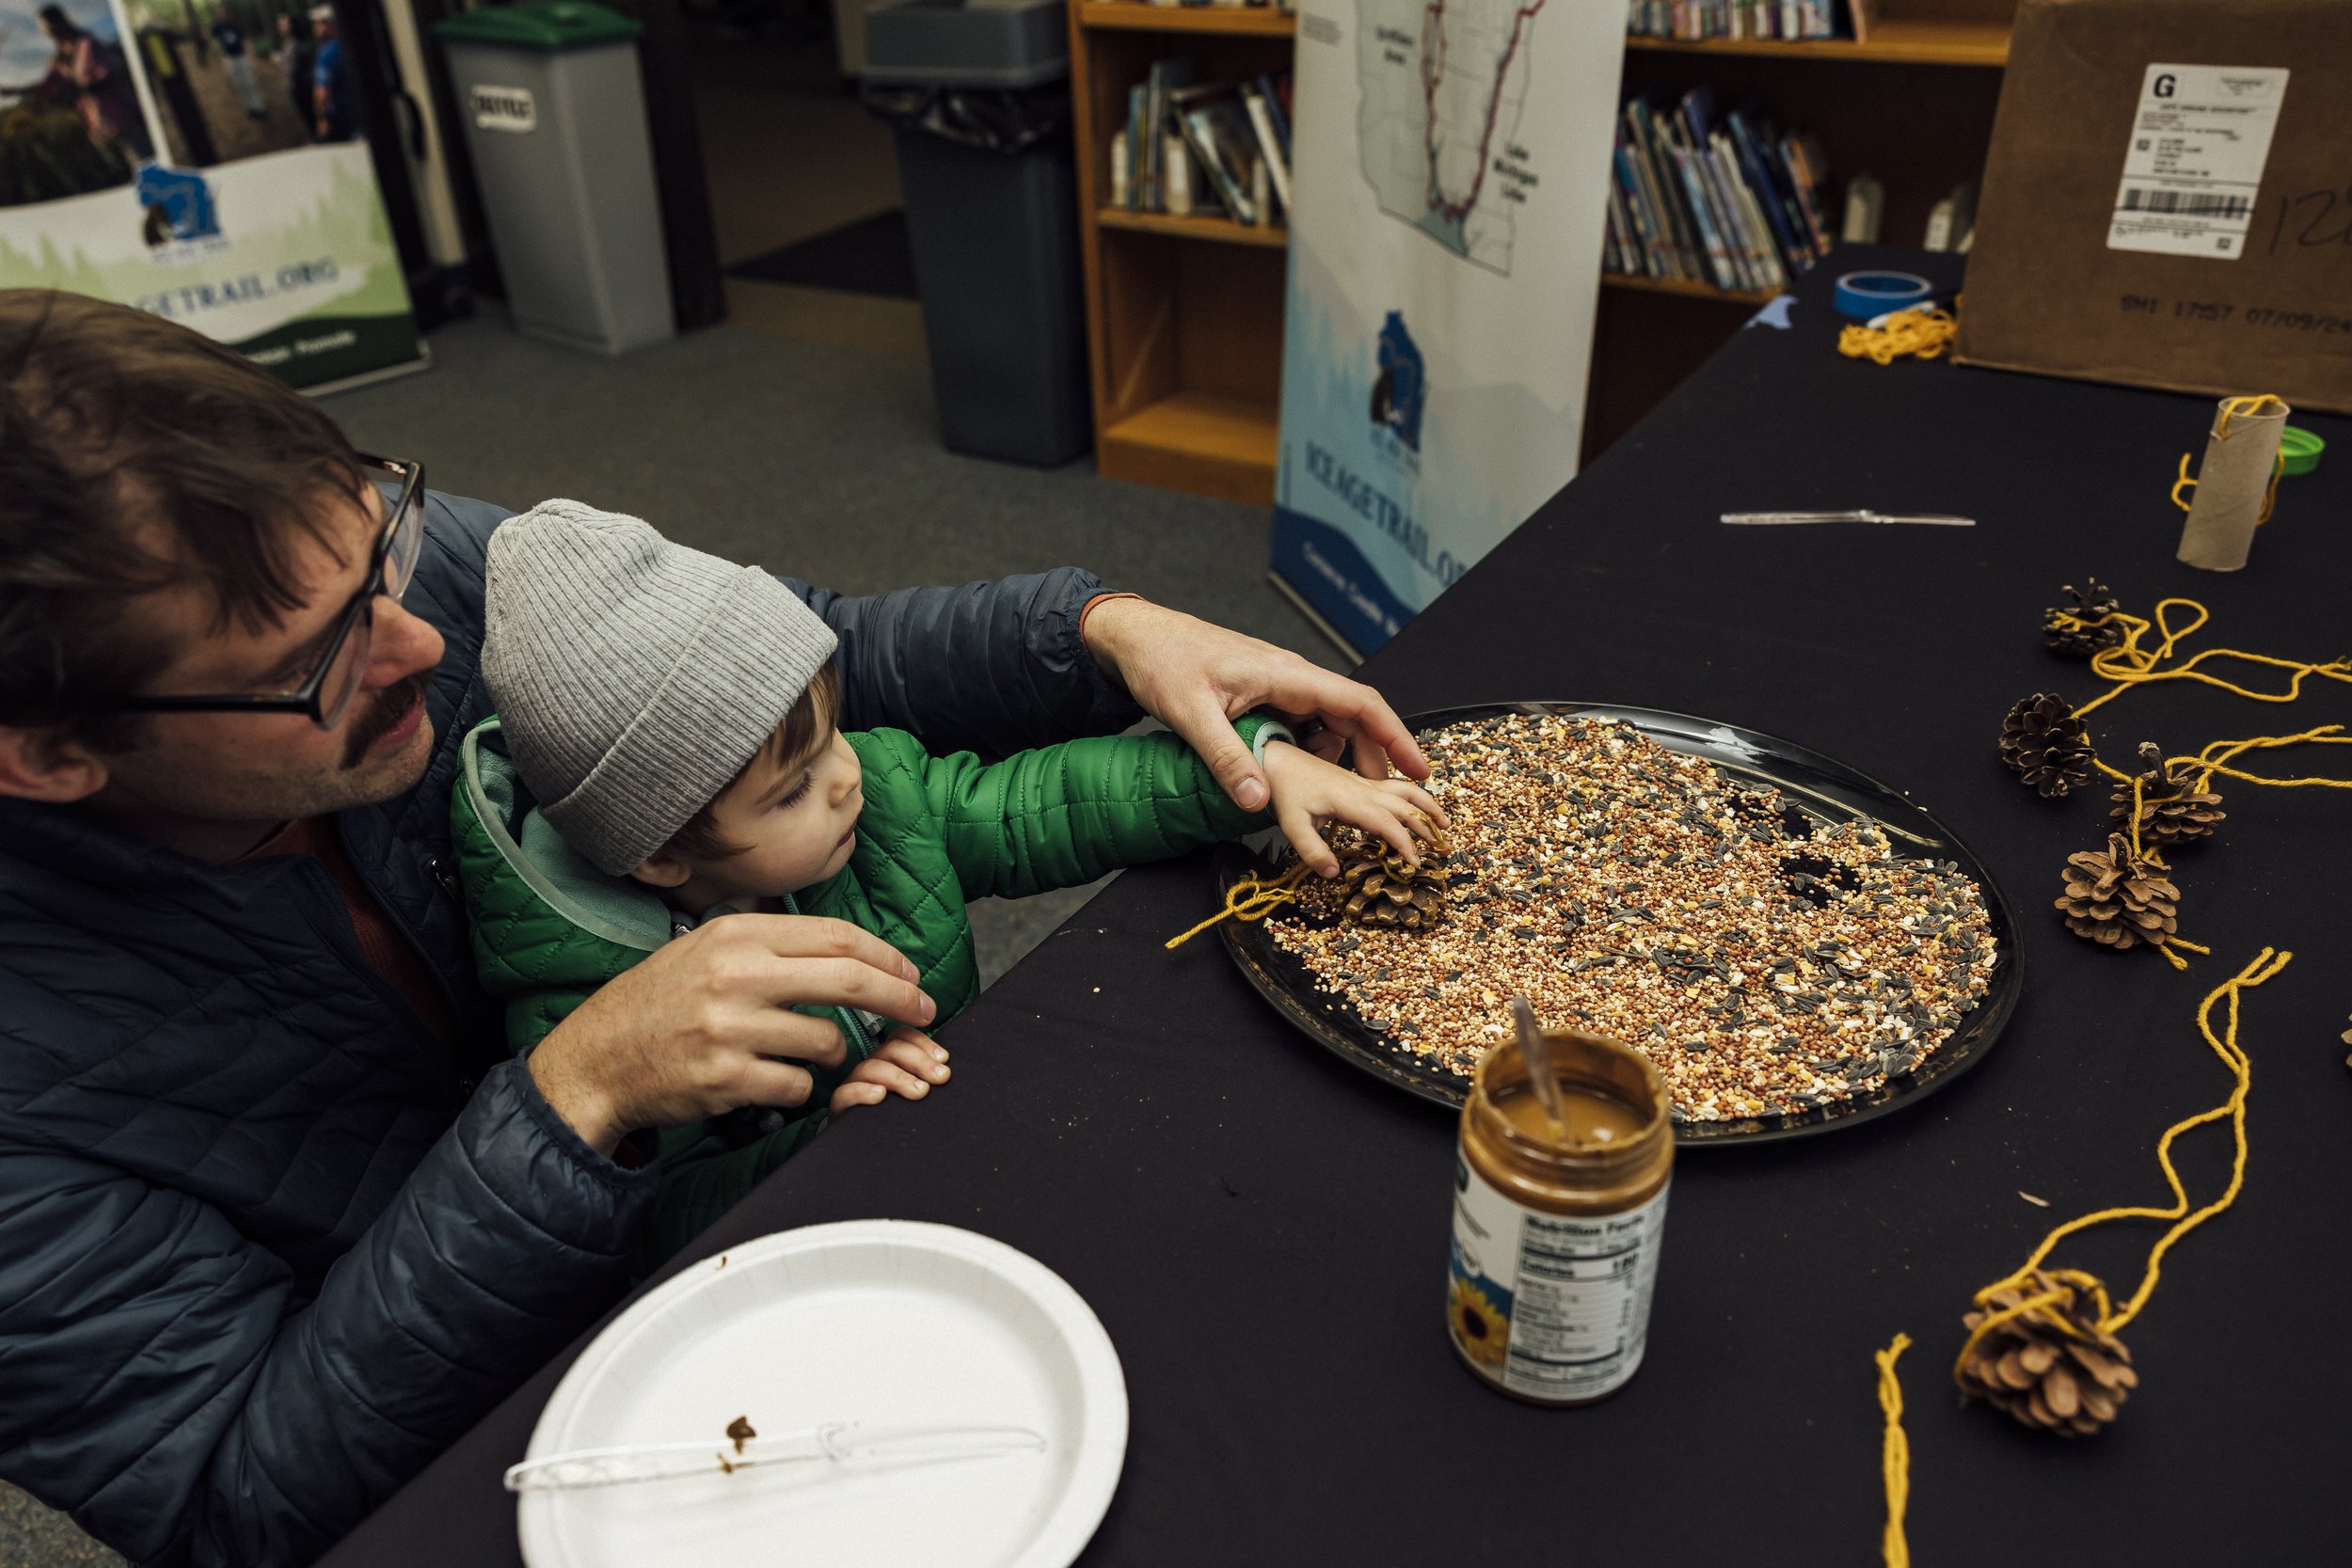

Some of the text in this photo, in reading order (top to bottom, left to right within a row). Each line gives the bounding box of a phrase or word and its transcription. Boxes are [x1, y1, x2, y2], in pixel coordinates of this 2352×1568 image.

[2153, 73, 2176, 99] G
[122, 257, 340, 318] GETRAIL.ORG
[1526, 1214, 1601, 1236] Nutrition
